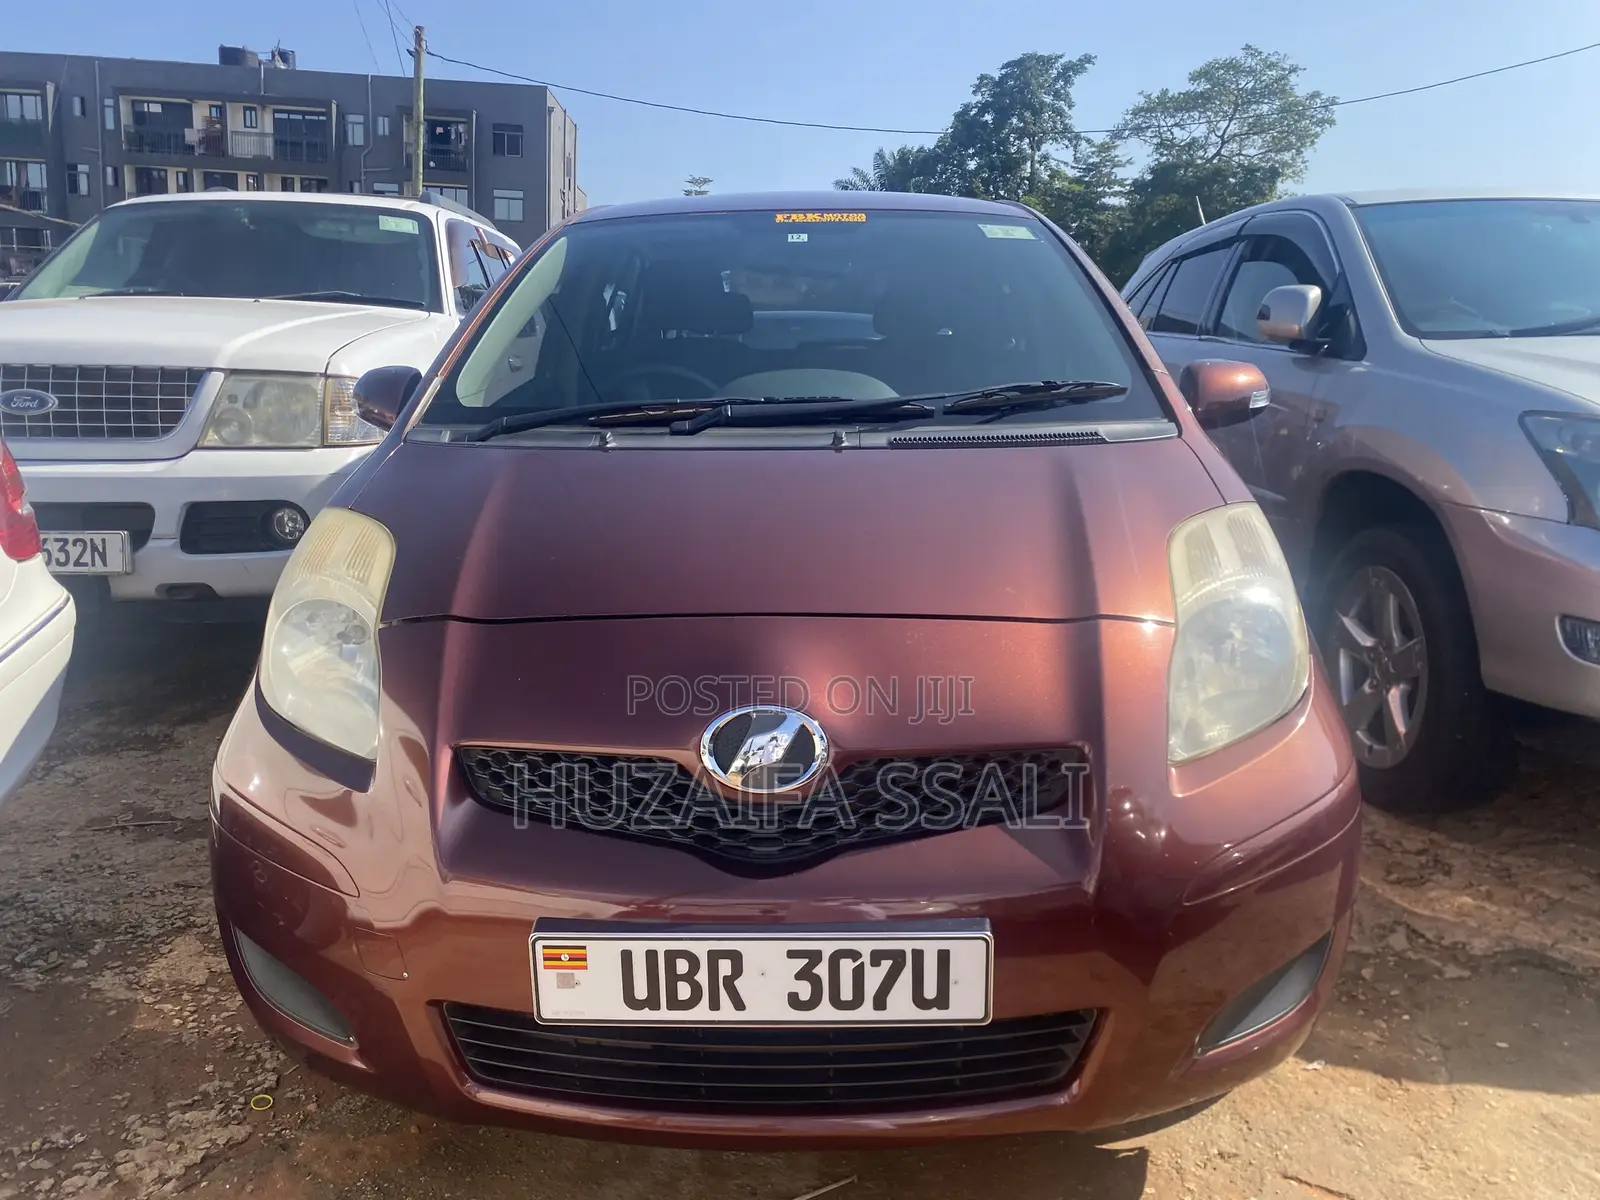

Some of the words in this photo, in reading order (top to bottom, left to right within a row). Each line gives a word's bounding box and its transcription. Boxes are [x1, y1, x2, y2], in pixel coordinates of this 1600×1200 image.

[11, 396, 39, 408] Ford
[620, 949, 747, 1012] UBR
[786, 949, 951, 1012] 307U
